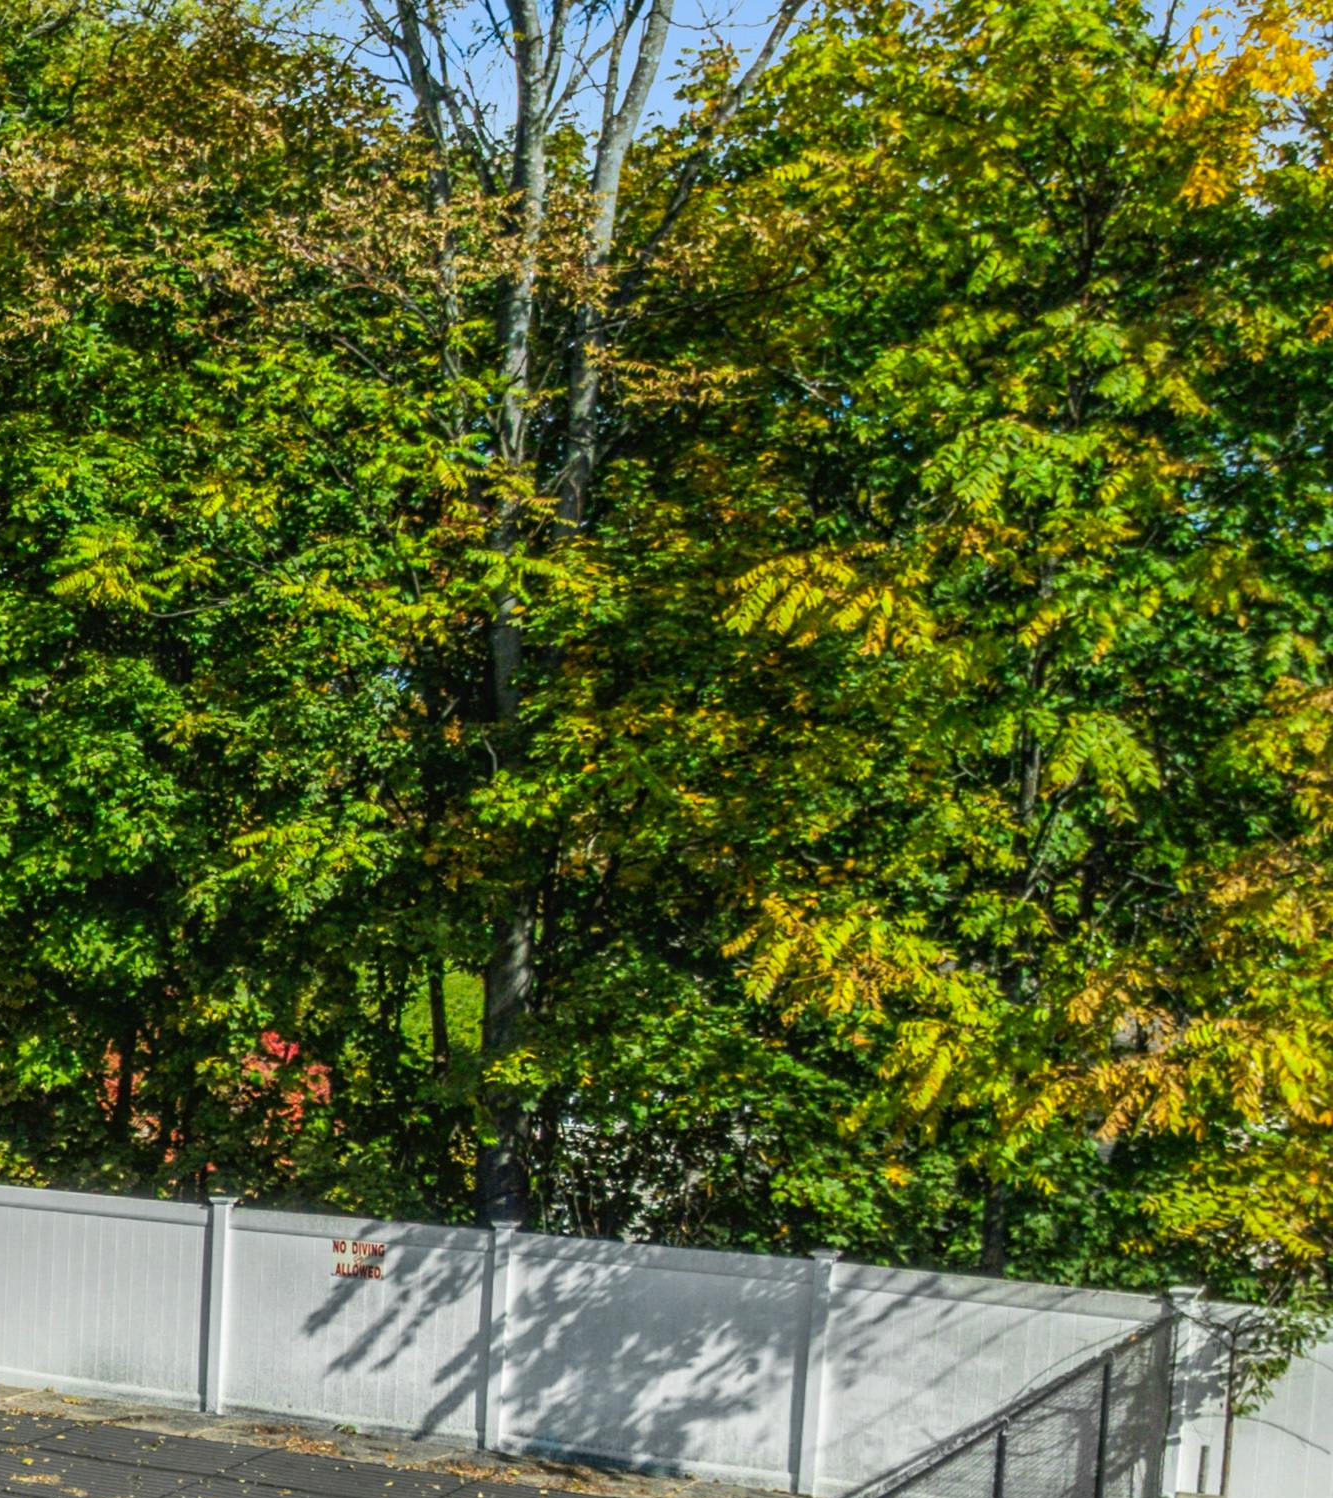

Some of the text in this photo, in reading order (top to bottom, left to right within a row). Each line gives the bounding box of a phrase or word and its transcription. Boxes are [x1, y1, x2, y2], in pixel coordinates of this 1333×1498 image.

[332, 1239, 385, 1257] NO DIVING
[335, 1262, 381, 1279] ALLOWED
